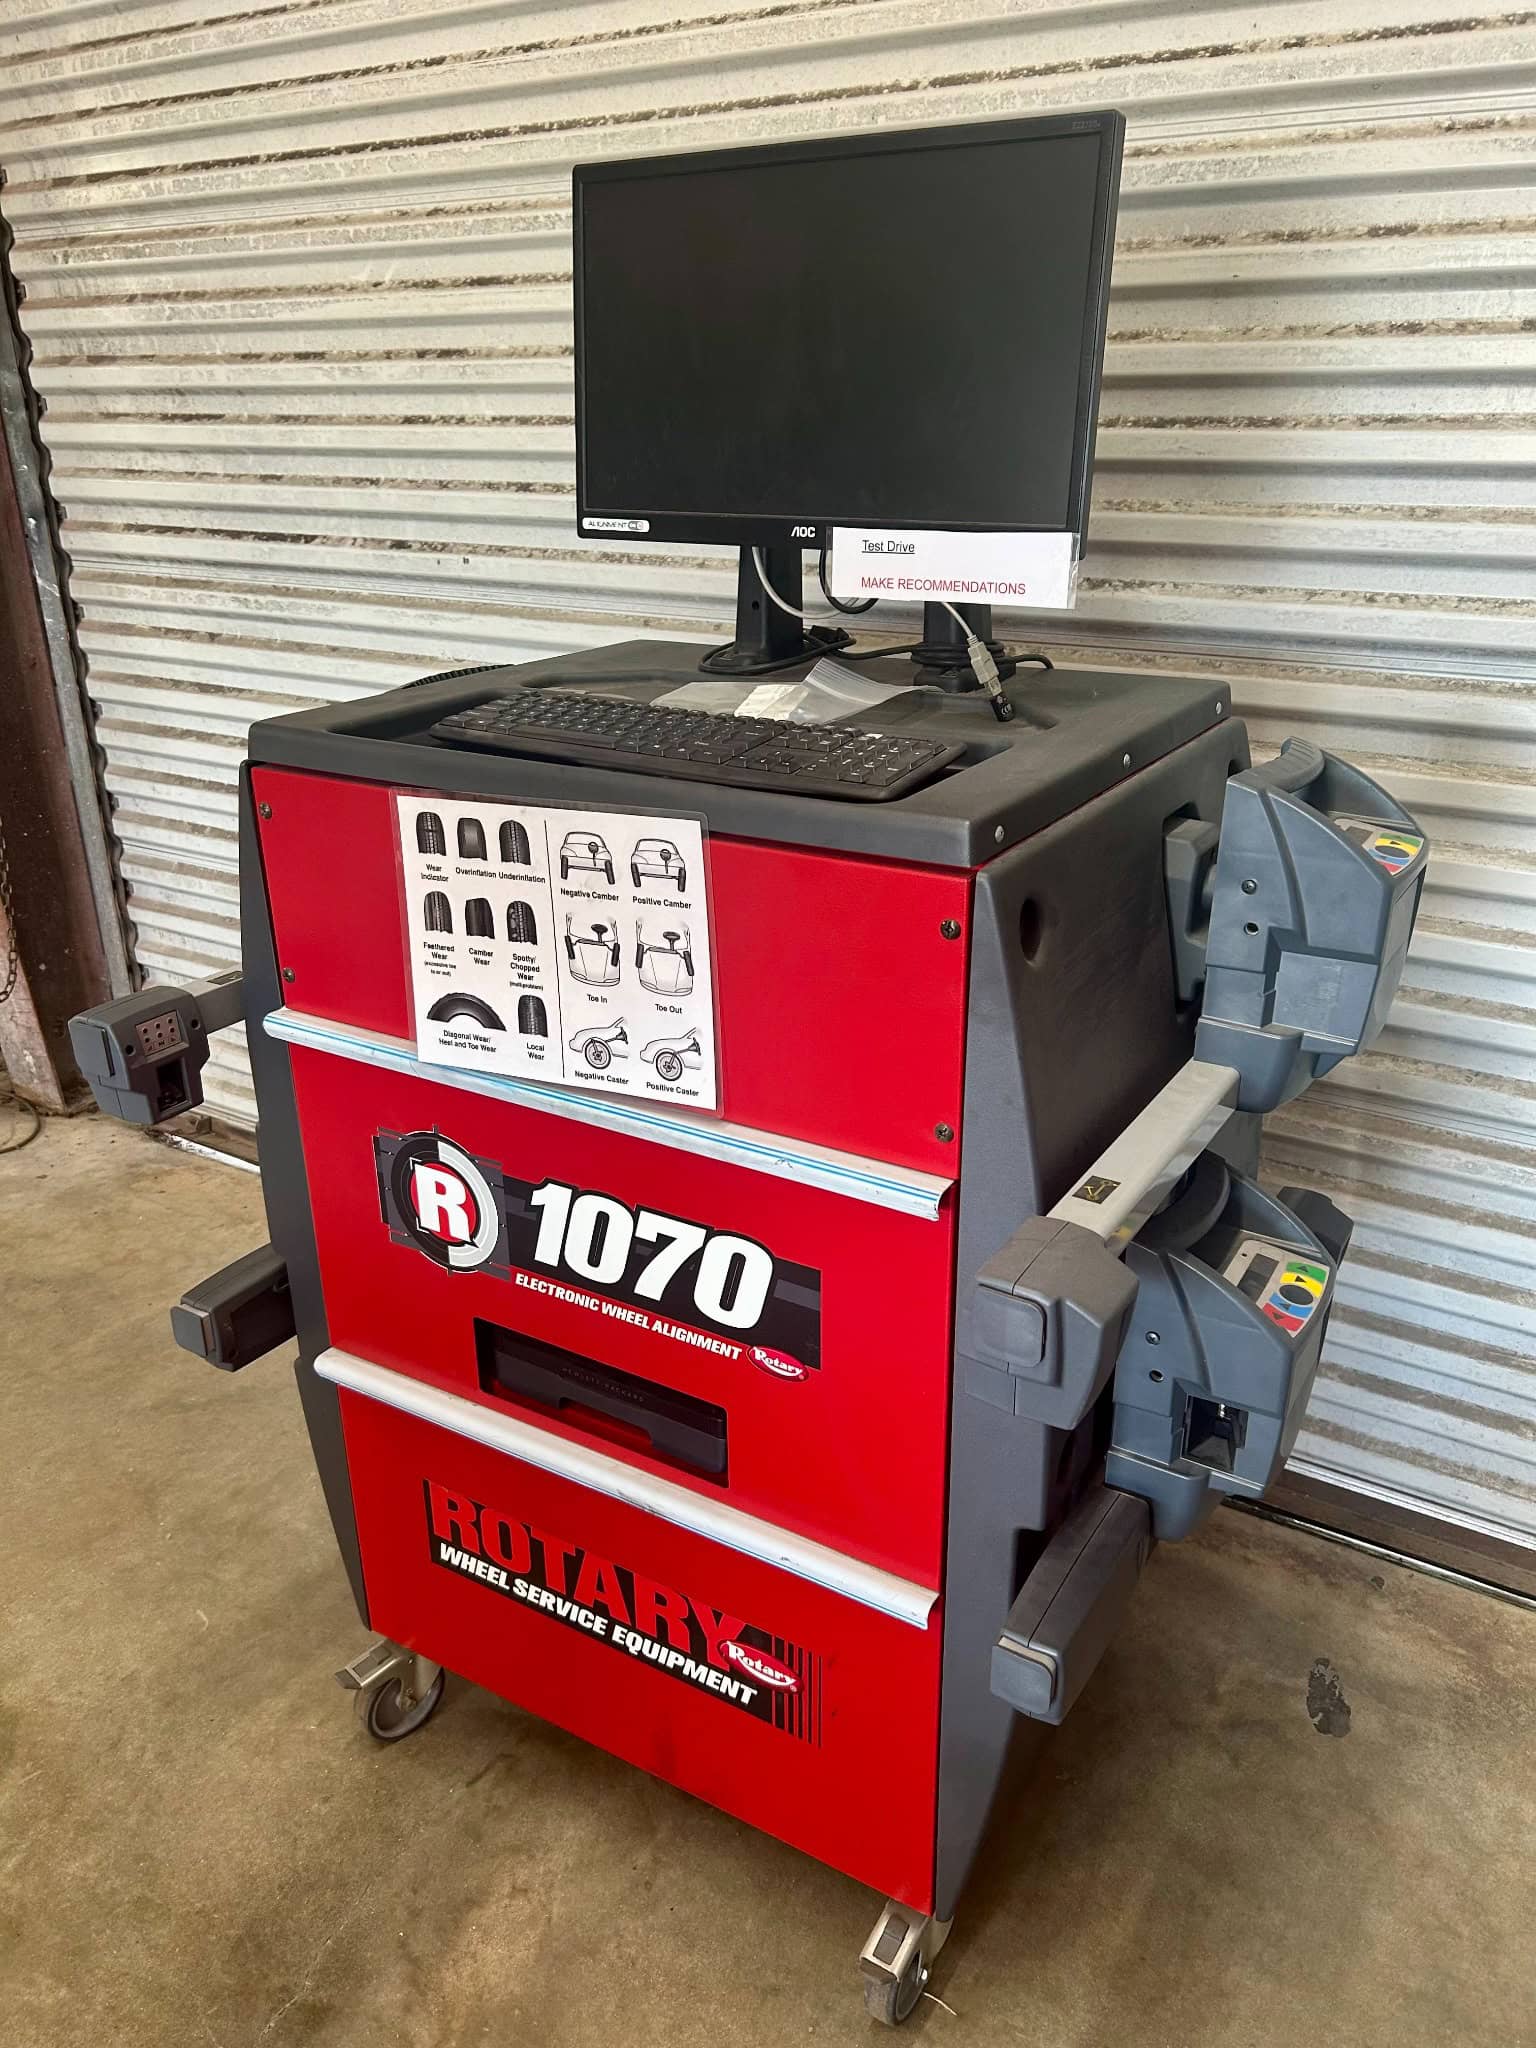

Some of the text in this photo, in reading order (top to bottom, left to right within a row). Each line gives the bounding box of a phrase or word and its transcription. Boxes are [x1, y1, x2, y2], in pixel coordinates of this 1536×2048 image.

[791, 526, 816, 538] AOC
[862, 539, 915, 553] Test Drive
[861, 577, 1026, 595] MAKE RECOMMENDATIONS
[426, 864, 442, 872] Wear
[455, 867, 497, 878] Overinflation
[421, 873, 449, 882] Indicator
[499, 872, 546, 883] Underinflation
[560, 887, 619, 902] Negative Camber
[632, 895, 692, 910] Positive Camber
[423, 942, 455, 952] Feathered
[468, 947, 493, 957] Camber
[432, 952, 448, 960] Wear
[474, 957, 490, 966] Wear
[510, 962, 540, 973] Chopped
[517, 972, 534, 981] Wear
[587, 994, 608, 1004] Toe In
[655, 1004, 682, 1014] Toe Out
[443, 1030, 471, 1040] Diagonal
[439, 1039, 497, 1053] Heel and Toe Wear
[526, 1042, 545, 1051] Local
[527, 1051, 545, 1060] Wear
[574, 1070, 629, 1085] Negative Caster
[646, 1081, 700, 1097] Positive Caster
[414, 1163, 774, 1330] R 1070
[515, 1273, 743, 1361] ELECTRONIC WHEEL ALIGNMENT
[752, 1346, 804, 1377] Rotary
[428, 1480, 747, 1671] ROTARY
[440, 1542, 758, 1706] WHEEL SERVICE EQUIPMENT
[726, 1641, 797, 1690] Rotary
